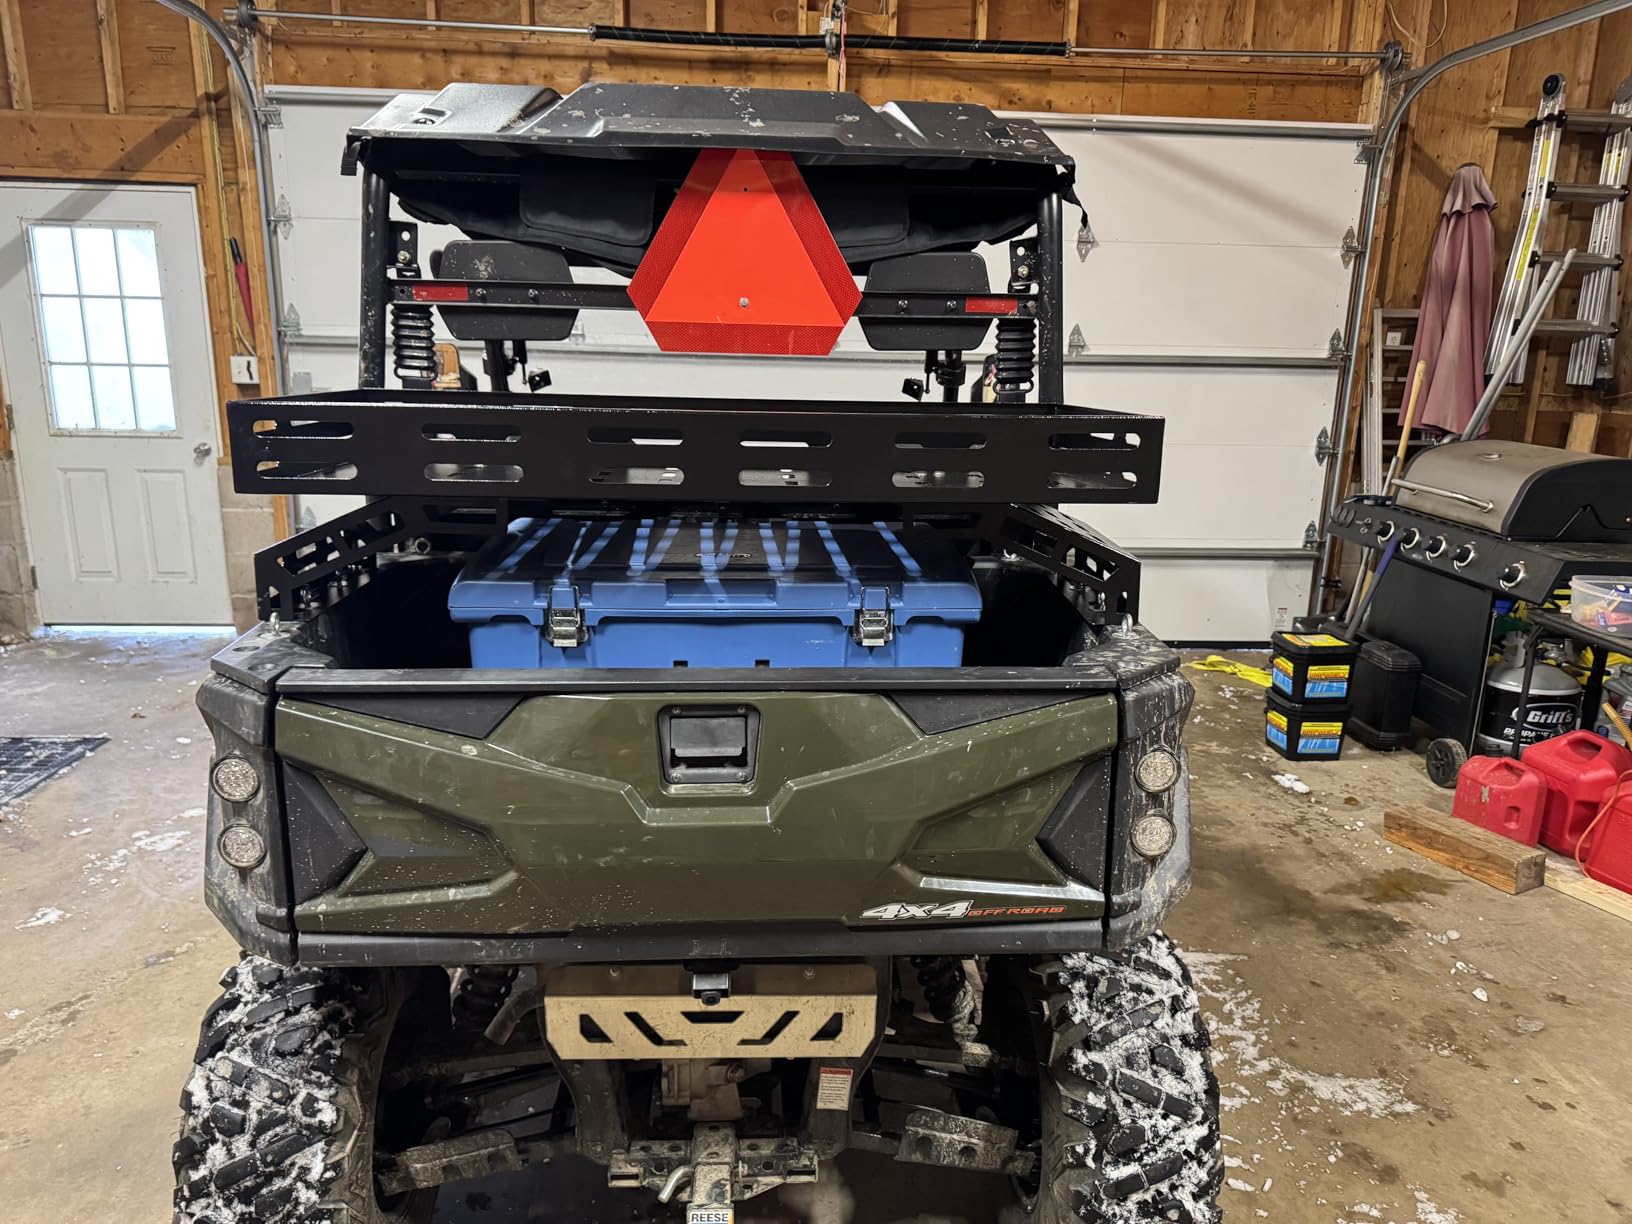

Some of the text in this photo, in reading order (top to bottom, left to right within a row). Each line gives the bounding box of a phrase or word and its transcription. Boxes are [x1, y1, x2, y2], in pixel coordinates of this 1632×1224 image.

[1526, 710, 1573, 723] Griff's
[967, 906, 1005, 917] OFF
[1006, 905, 1066, 915] ROAD
[691, 1213, 728, 1222] REESE
